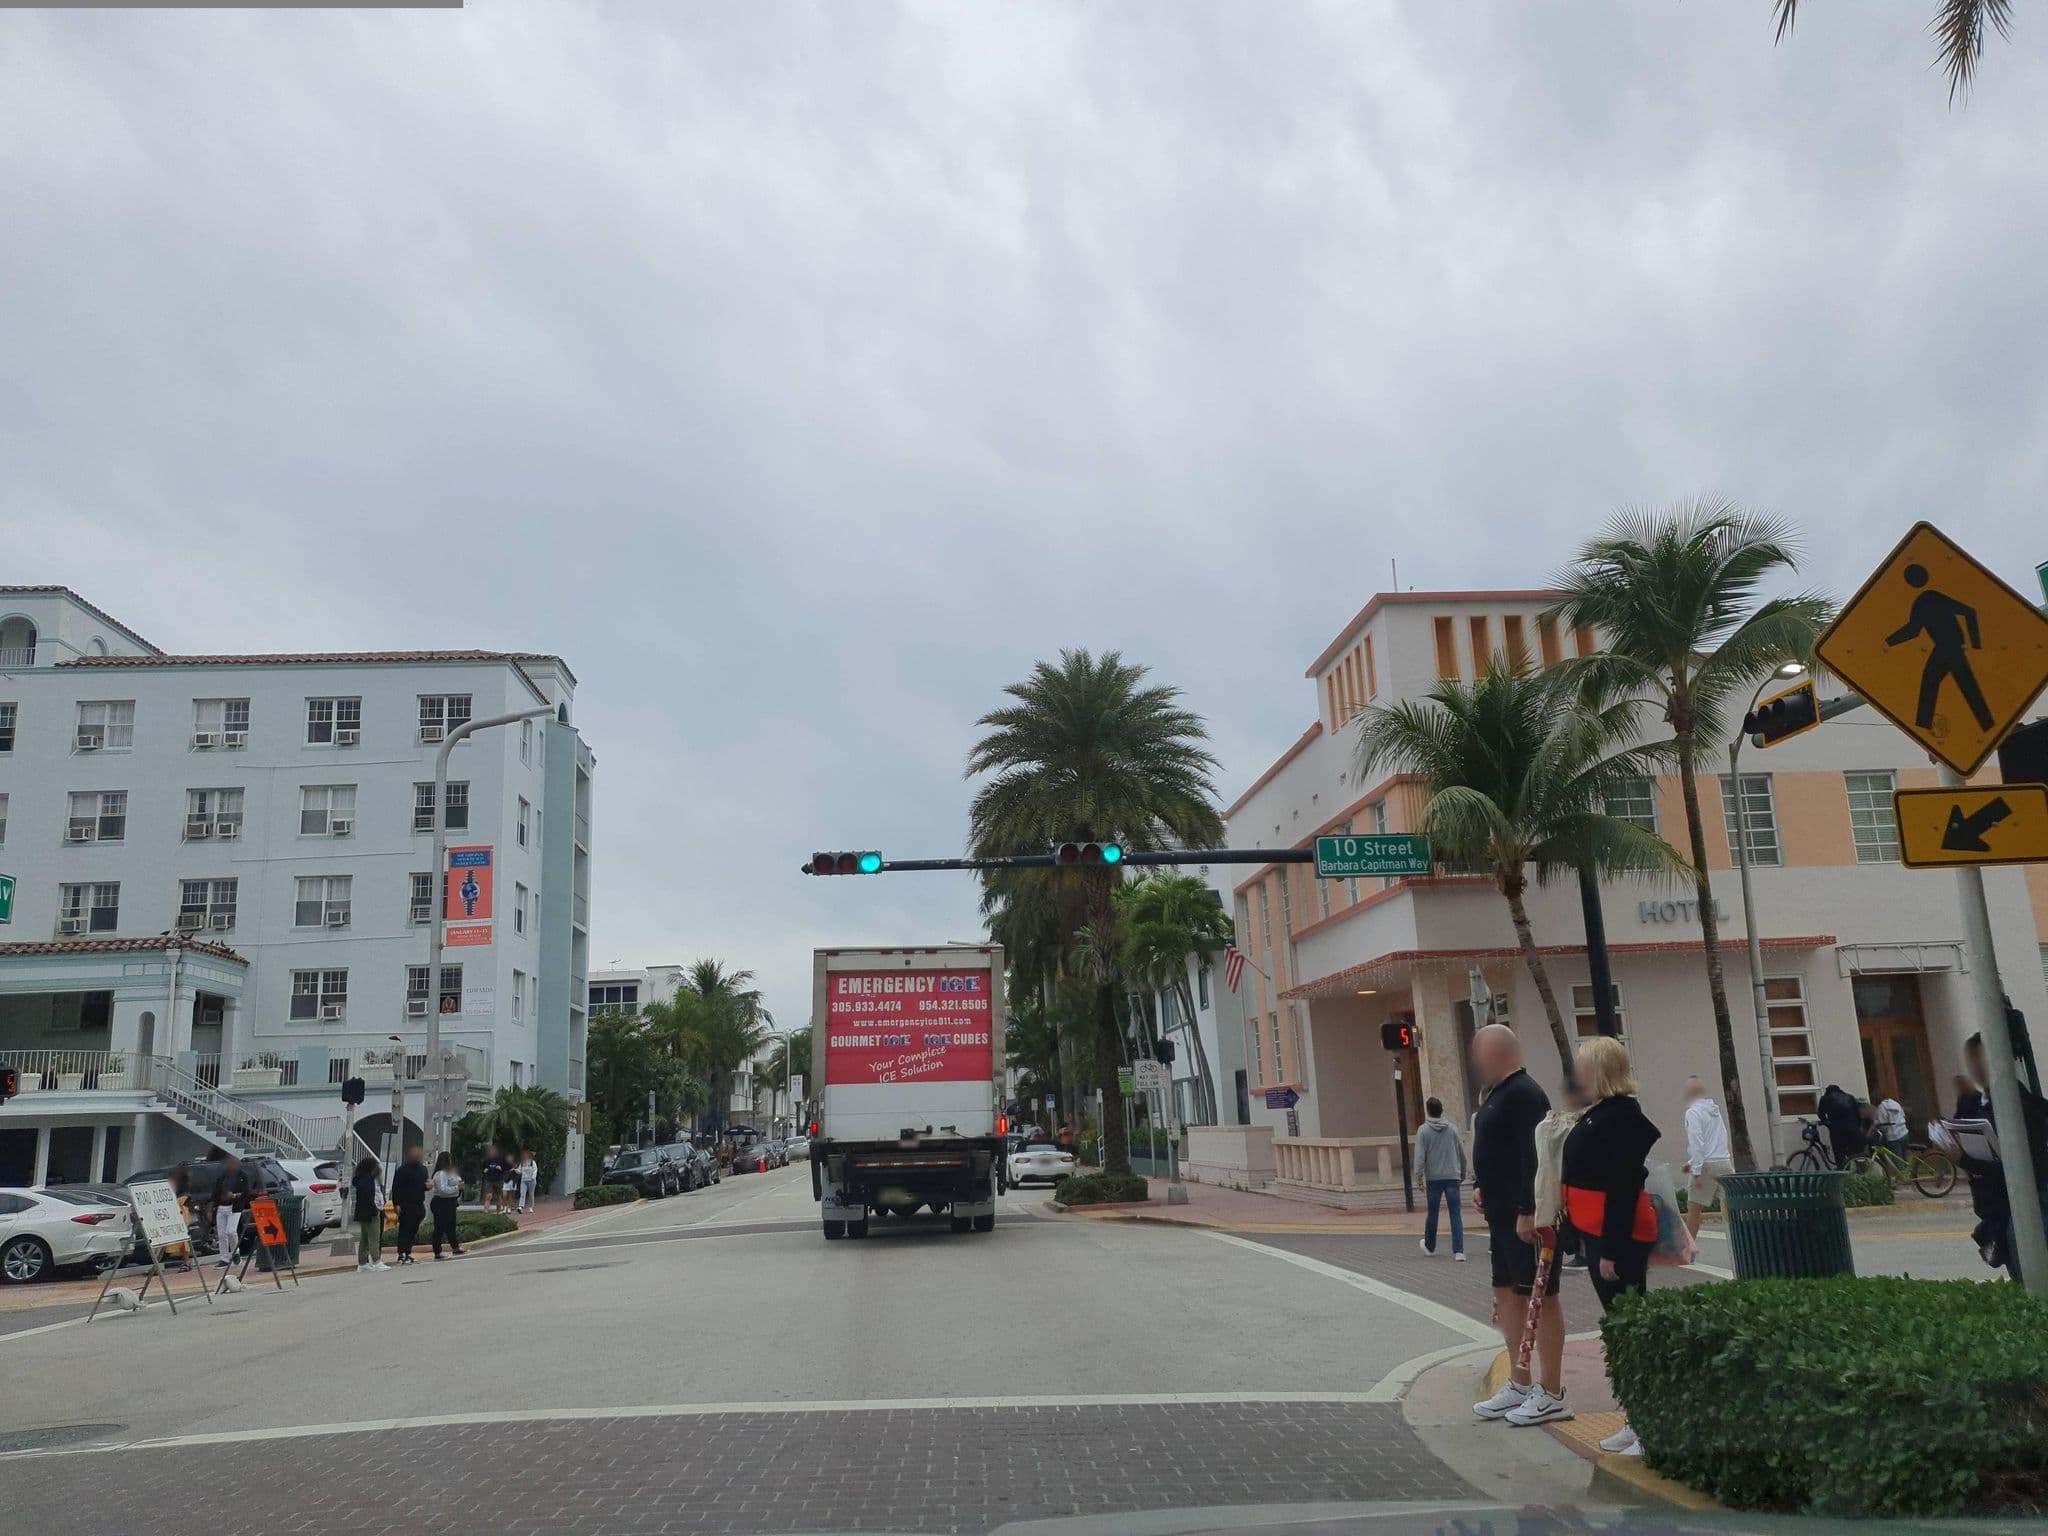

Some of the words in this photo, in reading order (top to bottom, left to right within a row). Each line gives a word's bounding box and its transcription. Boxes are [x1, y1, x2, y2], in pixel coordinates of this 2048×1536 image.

[1333, 838, 1357, 857] 10
[1364, 840, 1414, 856] Street
[1320, 860, 1359, 871] Barbara
[1360, 858, 1407, 872] Capitman
[1408, 857, 1429, 871] Way
[1638, 898, 1730, 924] HOTL
[838, 976, 936, 994] EMERGENCY
[940, 975, 981, 992] ICE
[832, 1000, 902, 1013] 305.933.4474
[919, 999, 988, 1011] 954.321.6505
[831, 1035, 881, 1047] GOURMET
[883, 1034, 911, 1047] ICE
[923, 1033, 951, 1046] ICE
[953, 1033, 989, 1045] CUBES
[1399, 1027, 1409, 1046] 5
[869, 1059, 894, 1072] Your
[897, 1045, 947, 1066] Complete
[879, 1071, 897, 1084] ICE
[901, 1059, 944, 1078] Solution
[135, 1191, 152, 1205] ROAD
[153, 1188, 174, 1203] CLOSED
